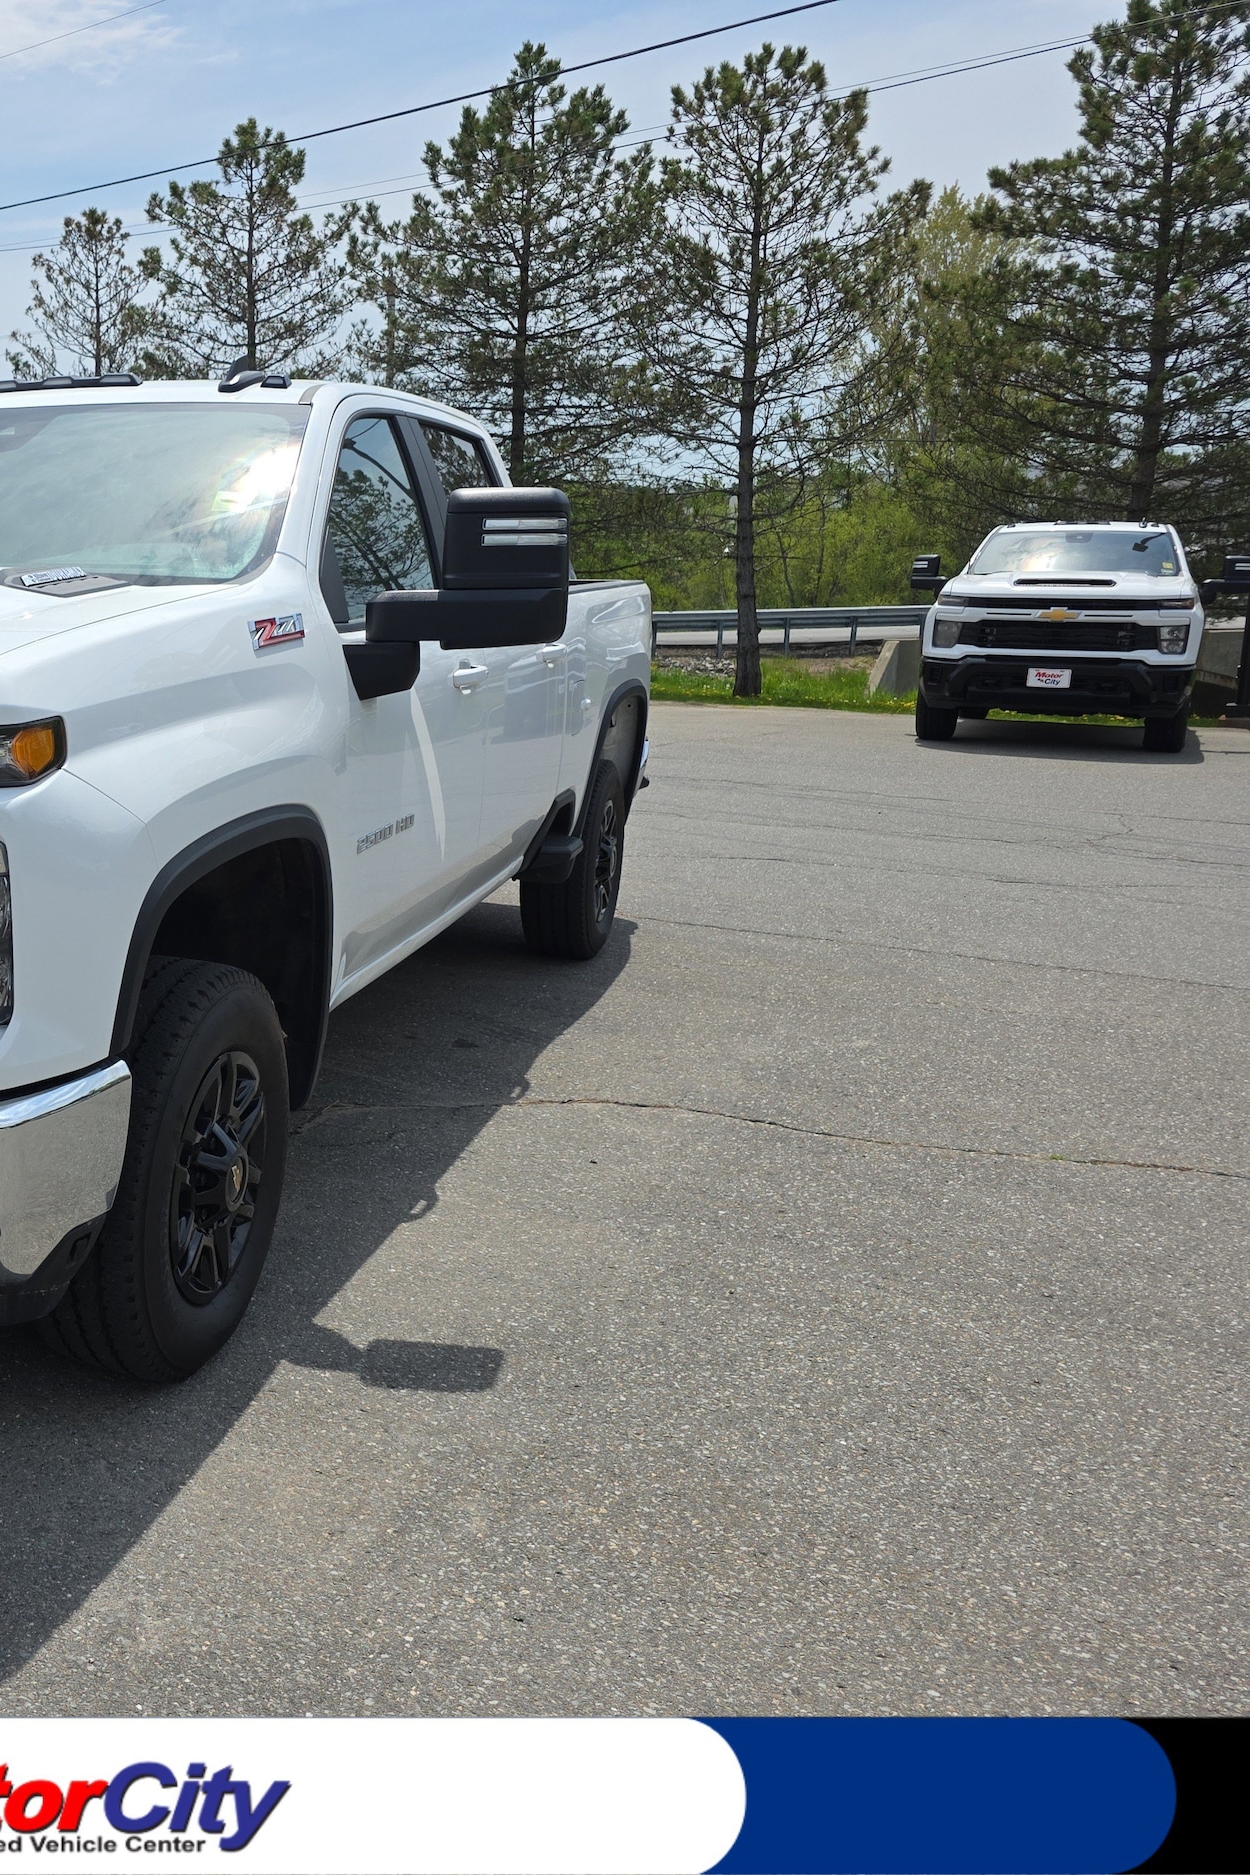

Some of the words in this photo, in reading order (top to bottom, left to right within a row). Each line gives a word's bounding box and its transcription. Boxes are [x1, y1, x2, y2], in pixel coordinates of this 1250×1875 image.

[1035, 671, 1064, 679] Motor
[1044, 678, 1060, 686] City
[356, 823, 393, 855] 2500
[395, 813, 415, 835] HD
